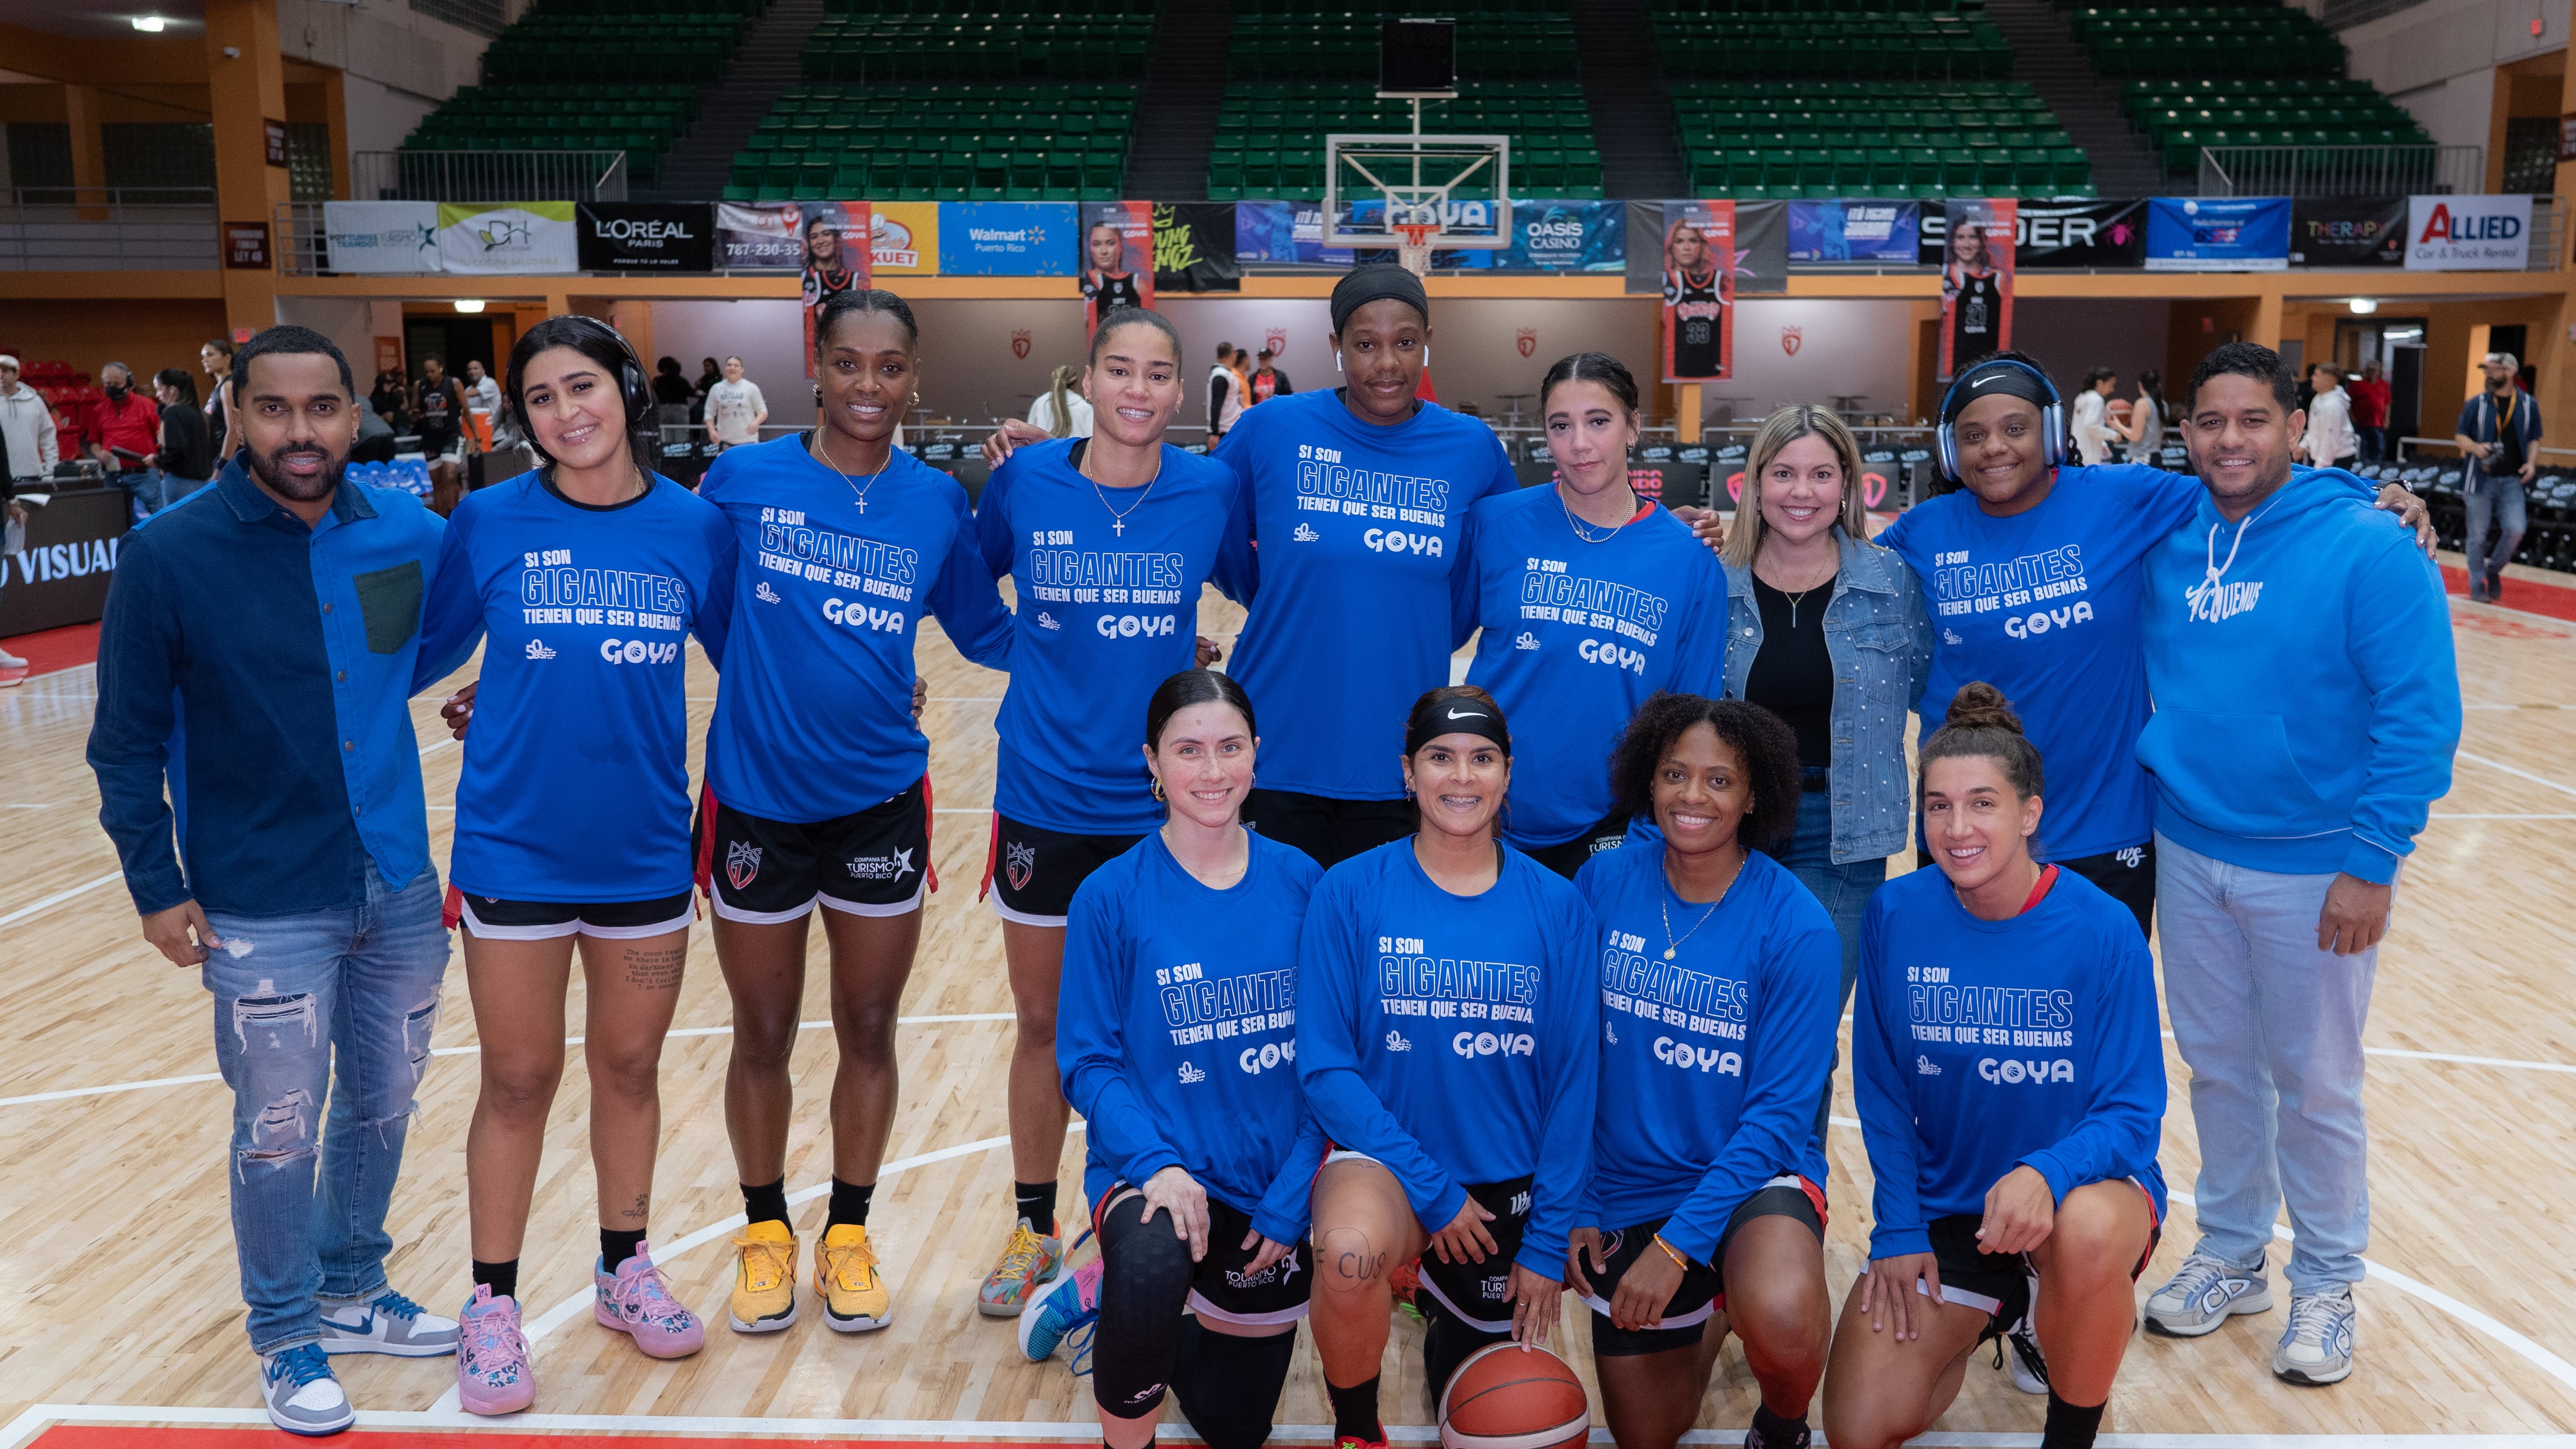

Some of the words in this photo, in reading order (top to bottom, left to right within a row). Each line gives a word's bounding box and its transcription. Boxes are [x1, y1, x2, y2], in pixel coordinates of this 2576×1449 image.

[596, 218, 693, 239] L'ORÉAL
[970, 228, 1026, 241] Walmart
[2420, 203, 2521, 244] ALLIED
[628, 239, 664, 248] PARIS
[726, 243, 800, 256] 787-230-35
[975, 243, 1005, 252] Puerto
[1007, 243, 1026, 252] Rico
[1530, 238, 1581, 249] CASINO
[1298, 444, 1312, 459] SI
[1315, 447, 1342, 464] SON
[1297, 461, 1450, 512] GIGANTES
[761, 507, 774, 523] SI
[778, 509, 805, 526] SON
[1297, 496, 1340, 513] TIENEN
[1342, 500, 1368, 516] QUE
[1371, 504, 1397, 520] SER
[1400, 508, 1446, 528] BUENAS
[1032, 531, 1045, 546] SI
[1047, 530, 1074, 545] SON
[1364, 528, 1443, 558] GOYA
[524, 552, 539, 567] SI
[542, 549, 571, 567] SON
[760, 520, 918, 585] GIGANTES
[1935, 552, 1944, 567] SI
[1946, 550, 1969, 565] SON
[758, 551, 803, 576] TIENEN
[804, 564, 832, 583] QUE
[834, 570, 861, 591] SER
[863, 578, 912, 602] BUENAS
[1030, 549, 1183, 588] GIGANTES
[1527, 558, 1539, 570] SI
[1541, 559, 1567, 574] SON
[1934, 544, 2083, 601] GIGANTES
[522, 568, 685, 614] GIGANTES
[1032, 585, 1071, 602] TIENEN
[1074, 588, 1099, 604] QUE
[1103, 589, 1129, 604] SER
[1132, 589, 1181, 604] BUENAS
[1521, 572, 1668, 631] GIGANTES
[1938, 600, 1972, 616] TIENEN
[1975, 596, 2000, 613] QUE
[2004, 589, 2031, 608] SER
[2033, 576, 2088, 601] BUENAS
[523, 609, 572, 624] TIENEN
[575, 609, 603, 626] QUE
[607, 610, 635, 627] SER
[638, 613, 682, 631] BUENAS
[823, 598, 904, 635] GOYA
[1096, 614, 1176, 639] GOYA
[1520, 605, 1560, 621] TIENEN
[1562, 608, 1588, 625] QUE
[1589, 613, 1615, 631] SER
[1615, 618, 1657, 647] BUENAS
[2005, 601, 2094, 639] GOYA
[600, 638, 677, 665] GOYA
[1579, 638, 1646, 676] GOYA
[846, 862, 894, 872] TURISMO
[1379, 936, 1392, 953] SI
[1395, 937, 1423, 954] SON
[1609, 930, 1620, 946] SI
[1620, 933, 1646, 953] SON
[1156, 968, 1170, 986] SI
[1173, 963, 1203, 983] SON
[1379, 956, 1540, 1005] GIGANTES
[1602, 948, 1749, 1022] GIGANTES
[1907, 966, 1919, 982] SI
[1923, 967, 1950, 983] SON
[1381, 999, 1427, 1016] TIENEN
[1431, 1001, 1457, 1019] QUE
[1461, 1002, 1488, 1019] SER
[1491, 1005, 1534, 1024] BUENA
[1908, 984, 2073, 1029] GIGANTES
[1170, 1024, 1213, 1046] TIENEN
[1216, 1019, 1239, 1040] QUE
[1241, 1015, 1266, 1034] SER
[1634, 999, 1660, 1020] QUE
[1663, 1007, 1686, 1029] SER
[1689, 1015, 1747, 1041] BUENAS
[1452, 1032, 1535, 1059] GOYA
[1911, 1024, 1951, 1042] TIENEN
[1955, 1026, 1979, 1044] QUE
[1983, 1029, 2009, 1046] SER
[2013, 1030, 2073, 1047] BUENAS
[1653, 1036, 1742, 1077] GOYA
[1978, 1057, 2074, 1085] GOYA
[1229, 1280, 1257, 1288] PUERTO
[1259, 1276, 1274, 1285] RICO
[1481, 1280, 1505, 1292] TURI
